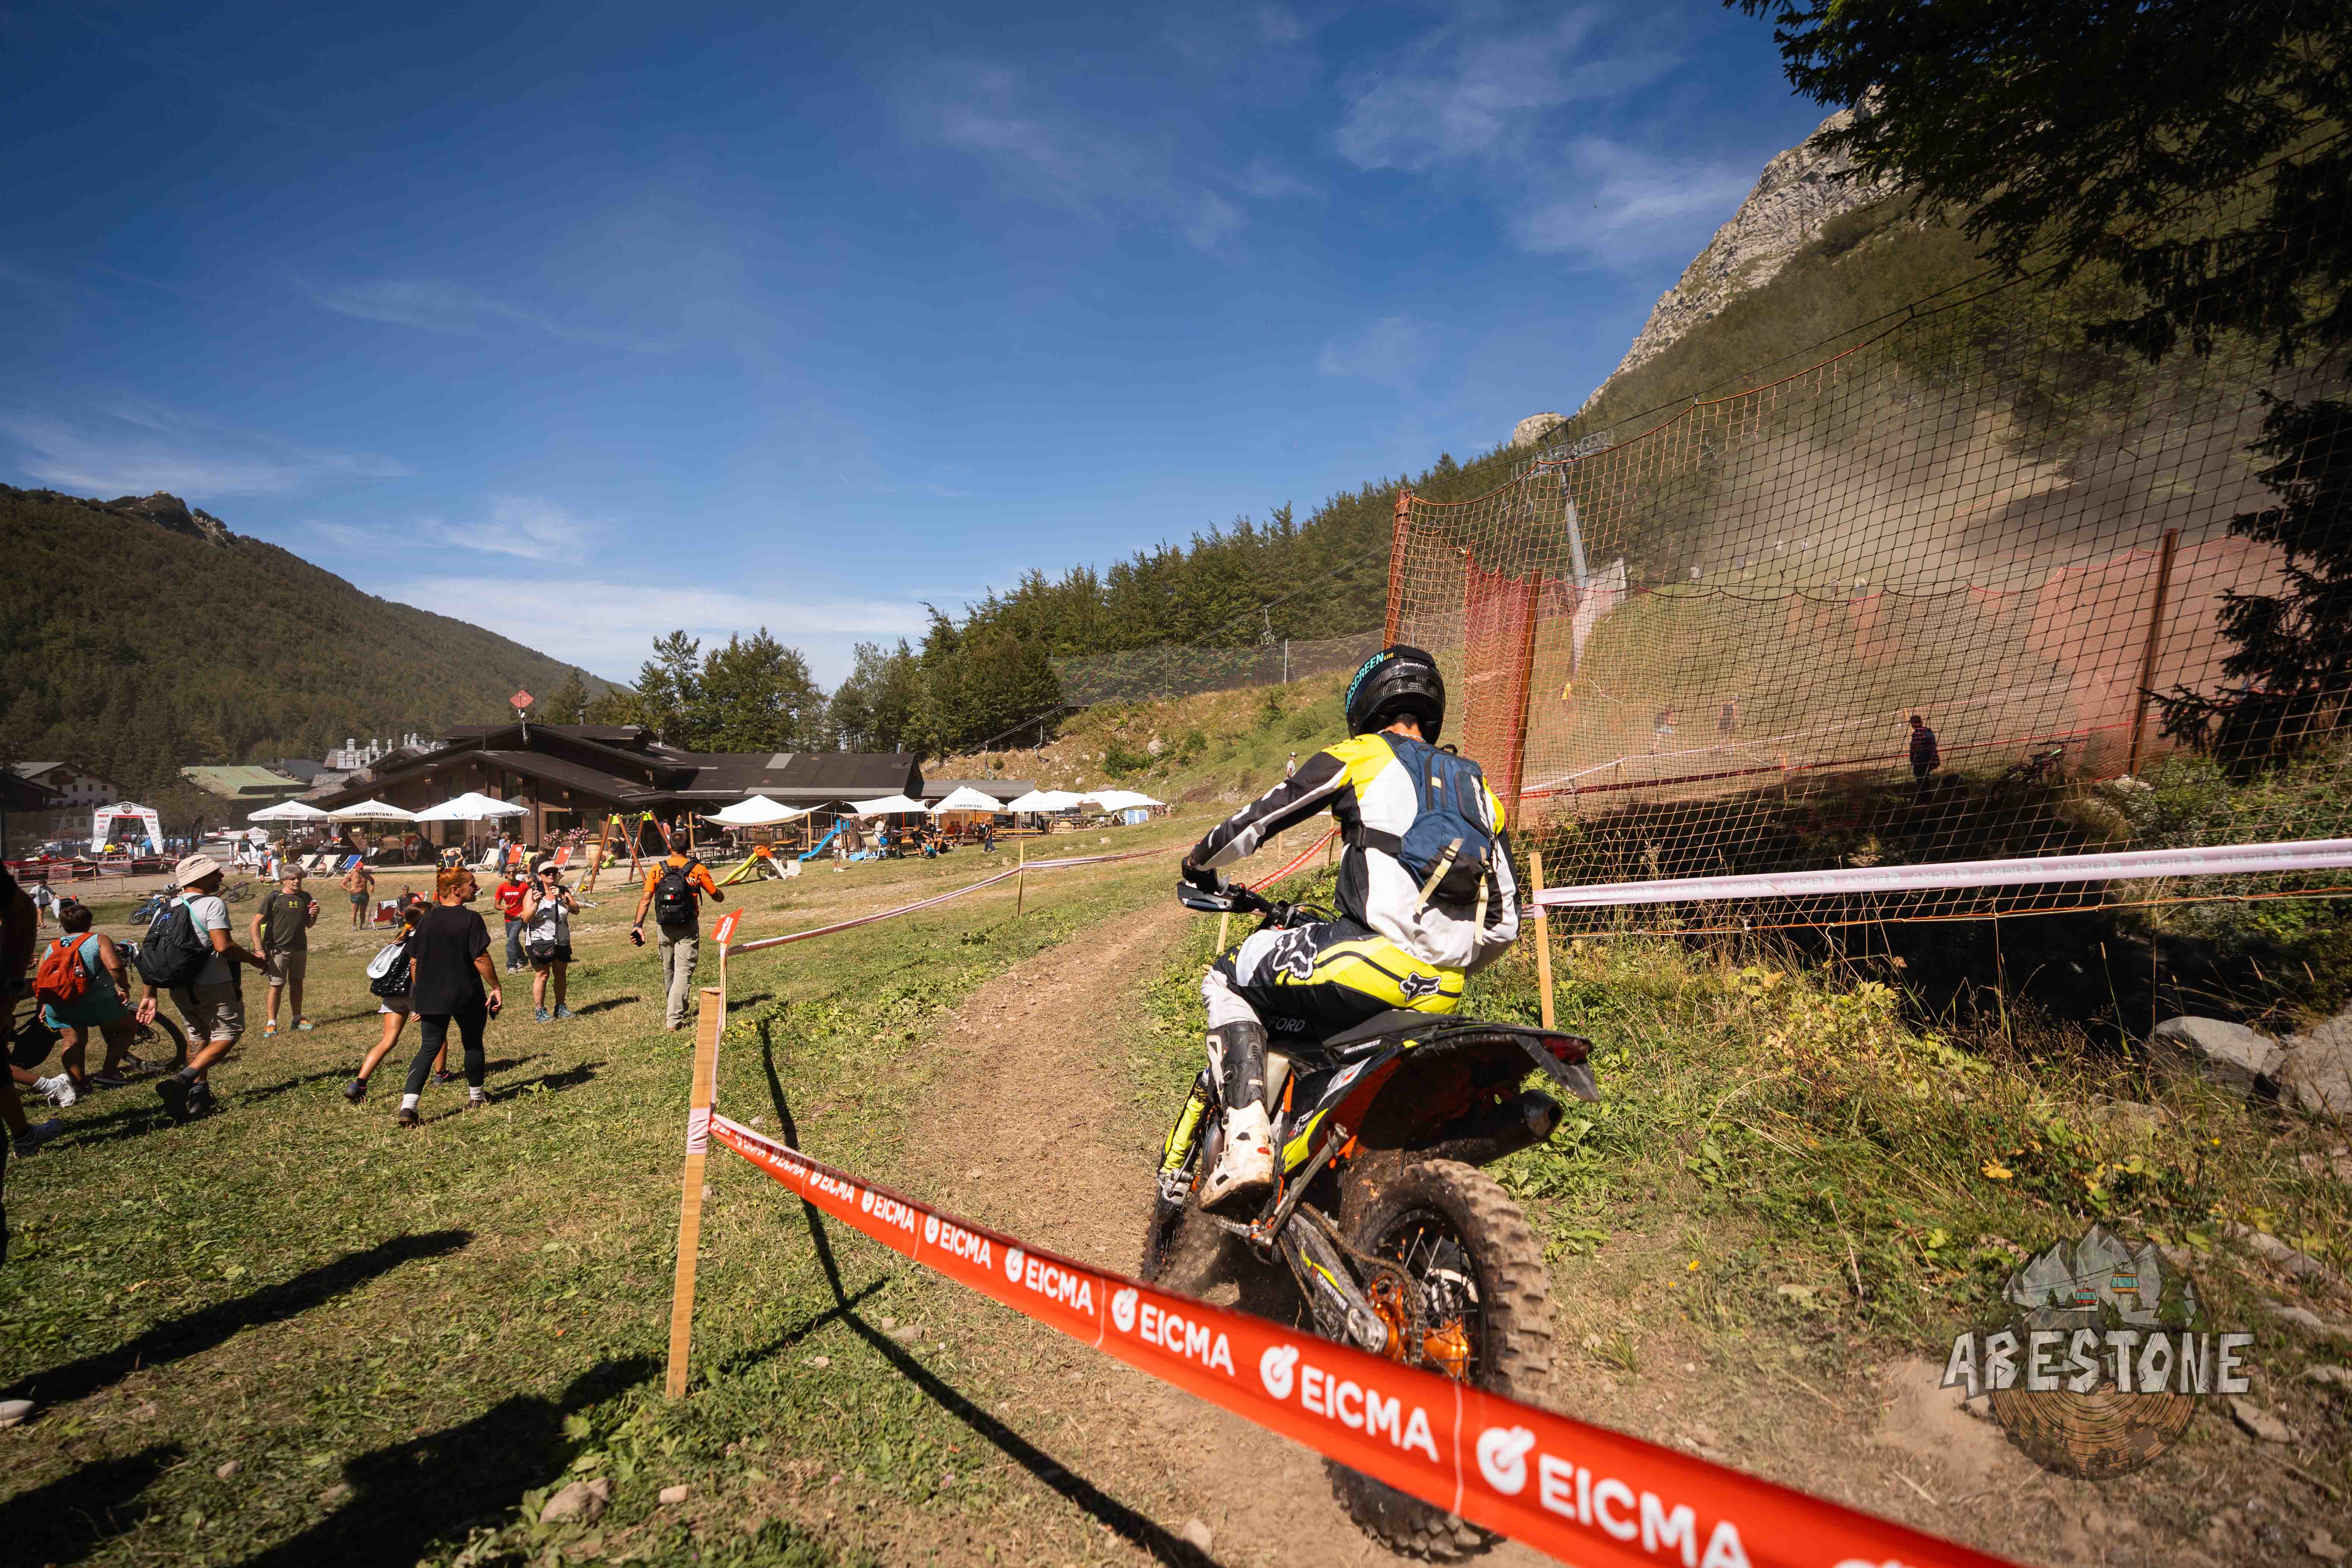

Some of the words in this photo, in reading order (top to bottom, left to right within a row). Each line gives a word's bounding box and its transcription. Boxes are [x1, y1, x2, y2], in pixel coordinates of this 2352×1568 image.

[775, 1157, 807, 1178] EICMA
[819, 1175, 855, 1204] EICMA
[873, 1195, 914, 1234] EICMA
[940, 1222, 992, 1270] EICMA
[1025, 1258, 1095, 1316] EICMA
[1140, 1303, 1235, 1377] EICMA
[1301, 1364, 1439, 1461] EICMA
[1539, 1453, 1752, 1568] EICMA
